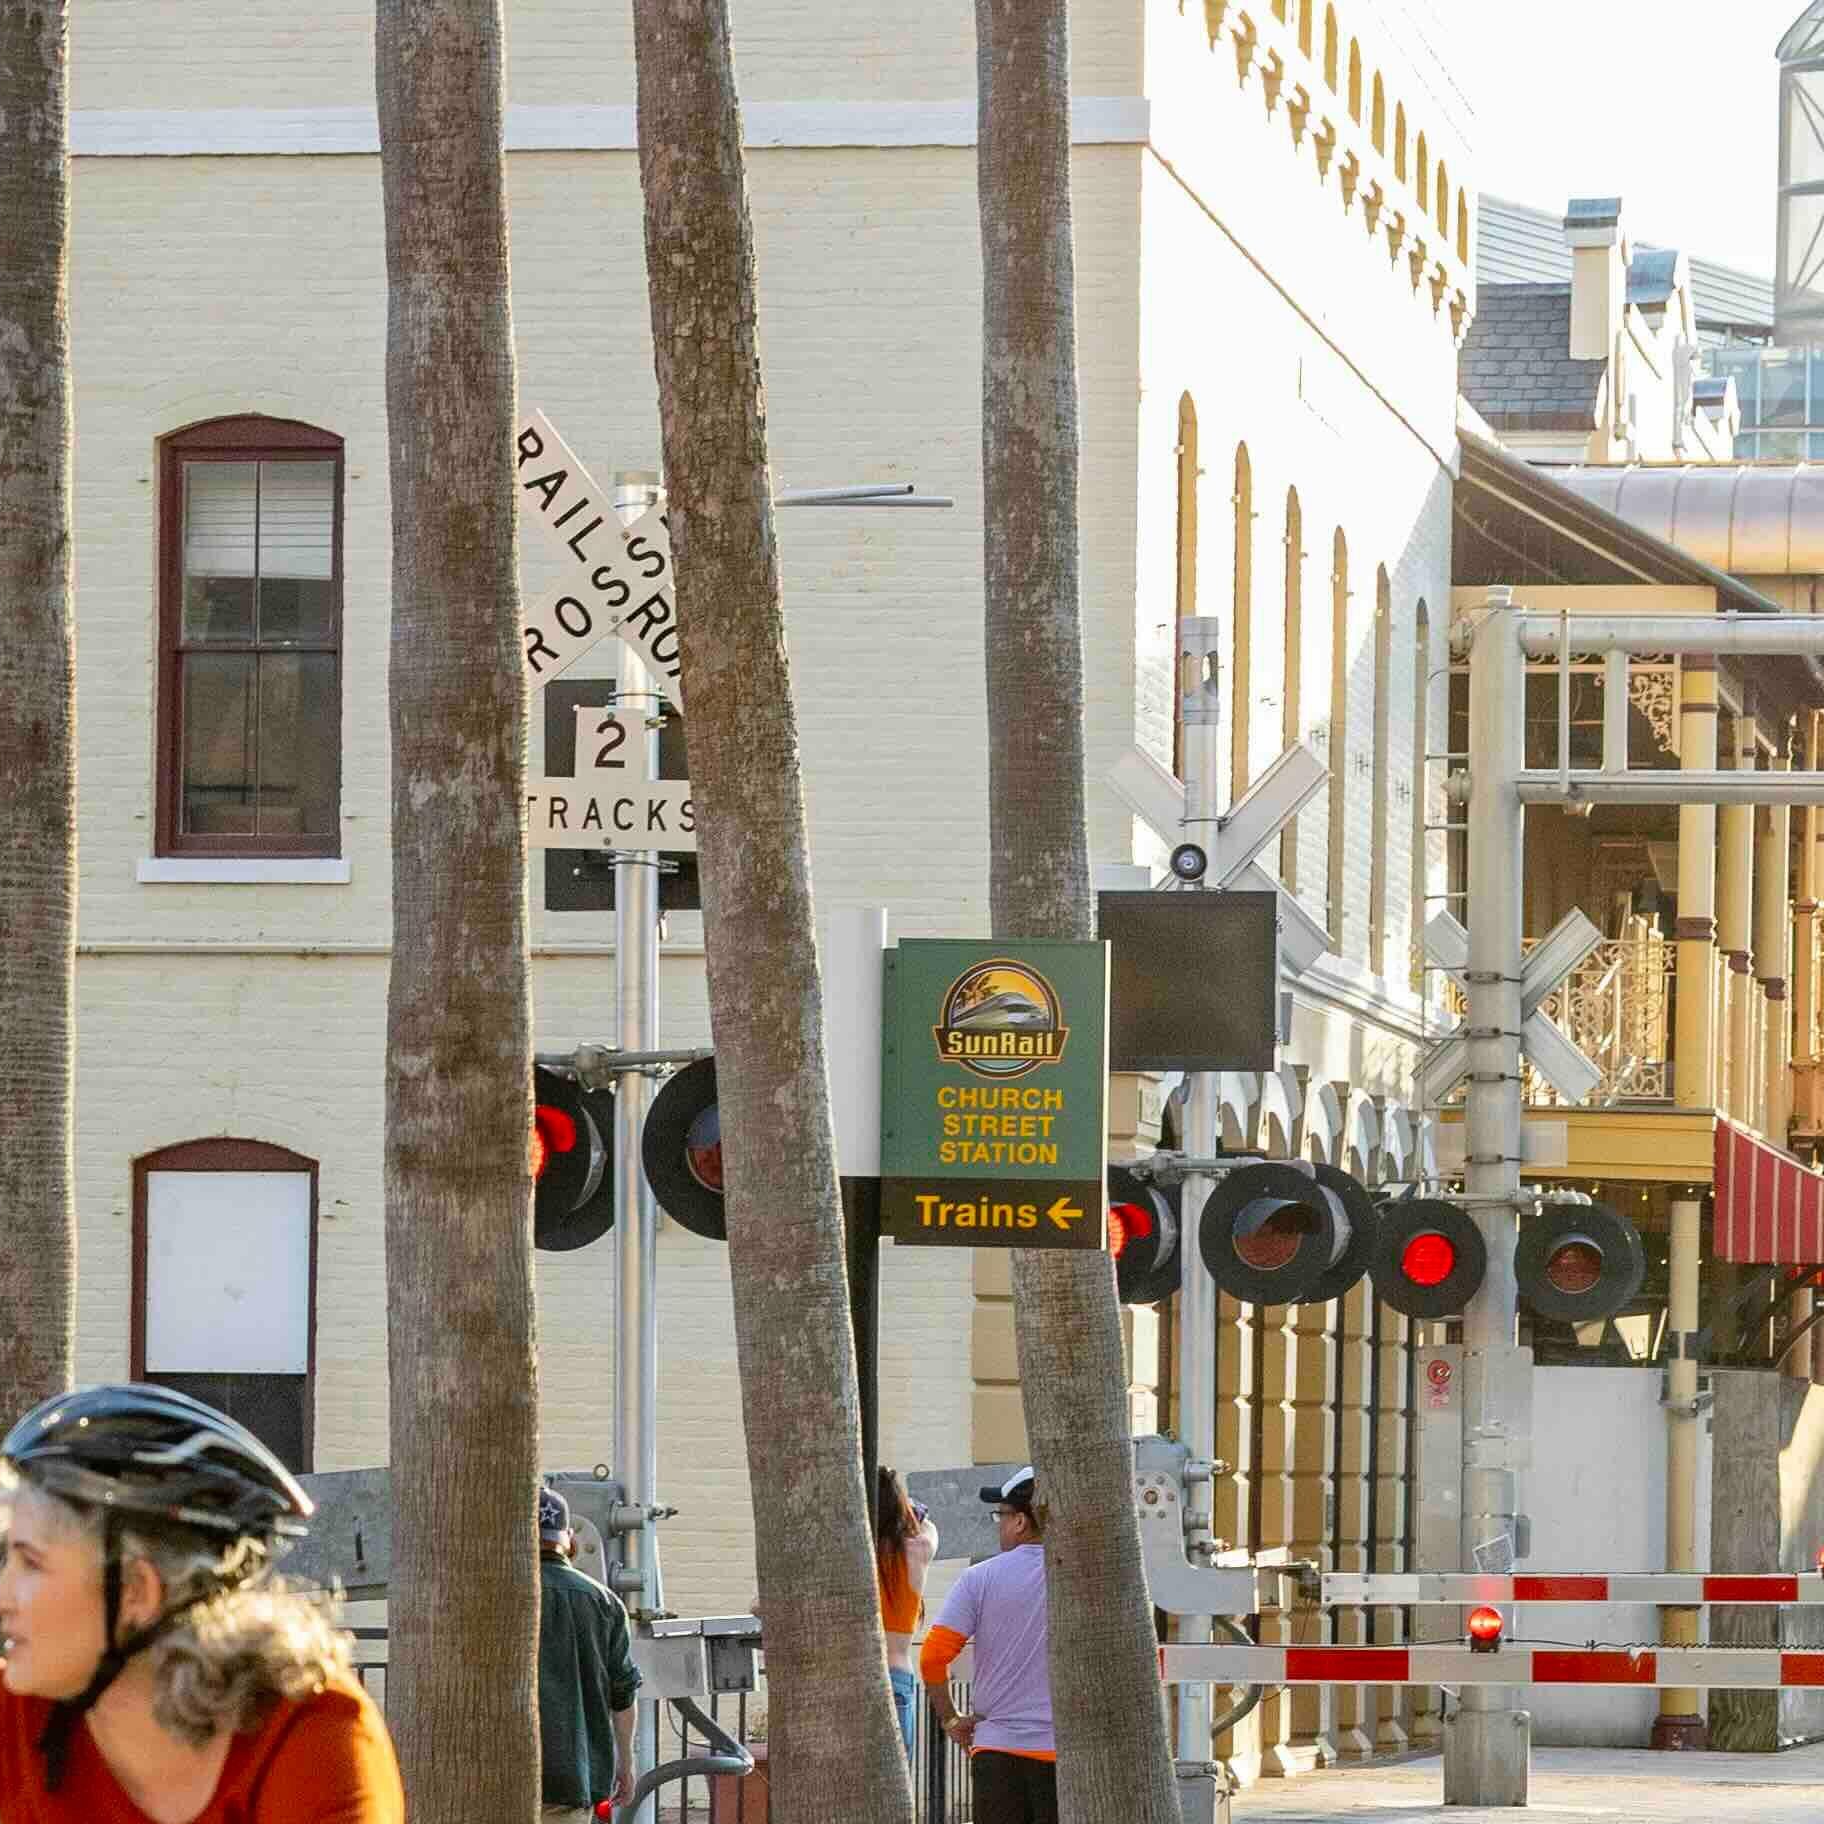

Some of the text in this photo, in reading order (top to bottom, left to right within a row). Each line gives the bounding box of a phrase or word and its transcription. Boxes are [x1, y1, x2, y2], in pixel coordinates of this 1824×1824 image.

[594, 719, 627, 769] 2
[947, 1030, 1054, 1056] SunRail
[937, 1086, 1064, 1110] CHURCH
[943, 1114, 1056, 1136] STREET
[940, 1140, 1058, 1165] STATION
[915, 1194, 1038, 1229] Trains
